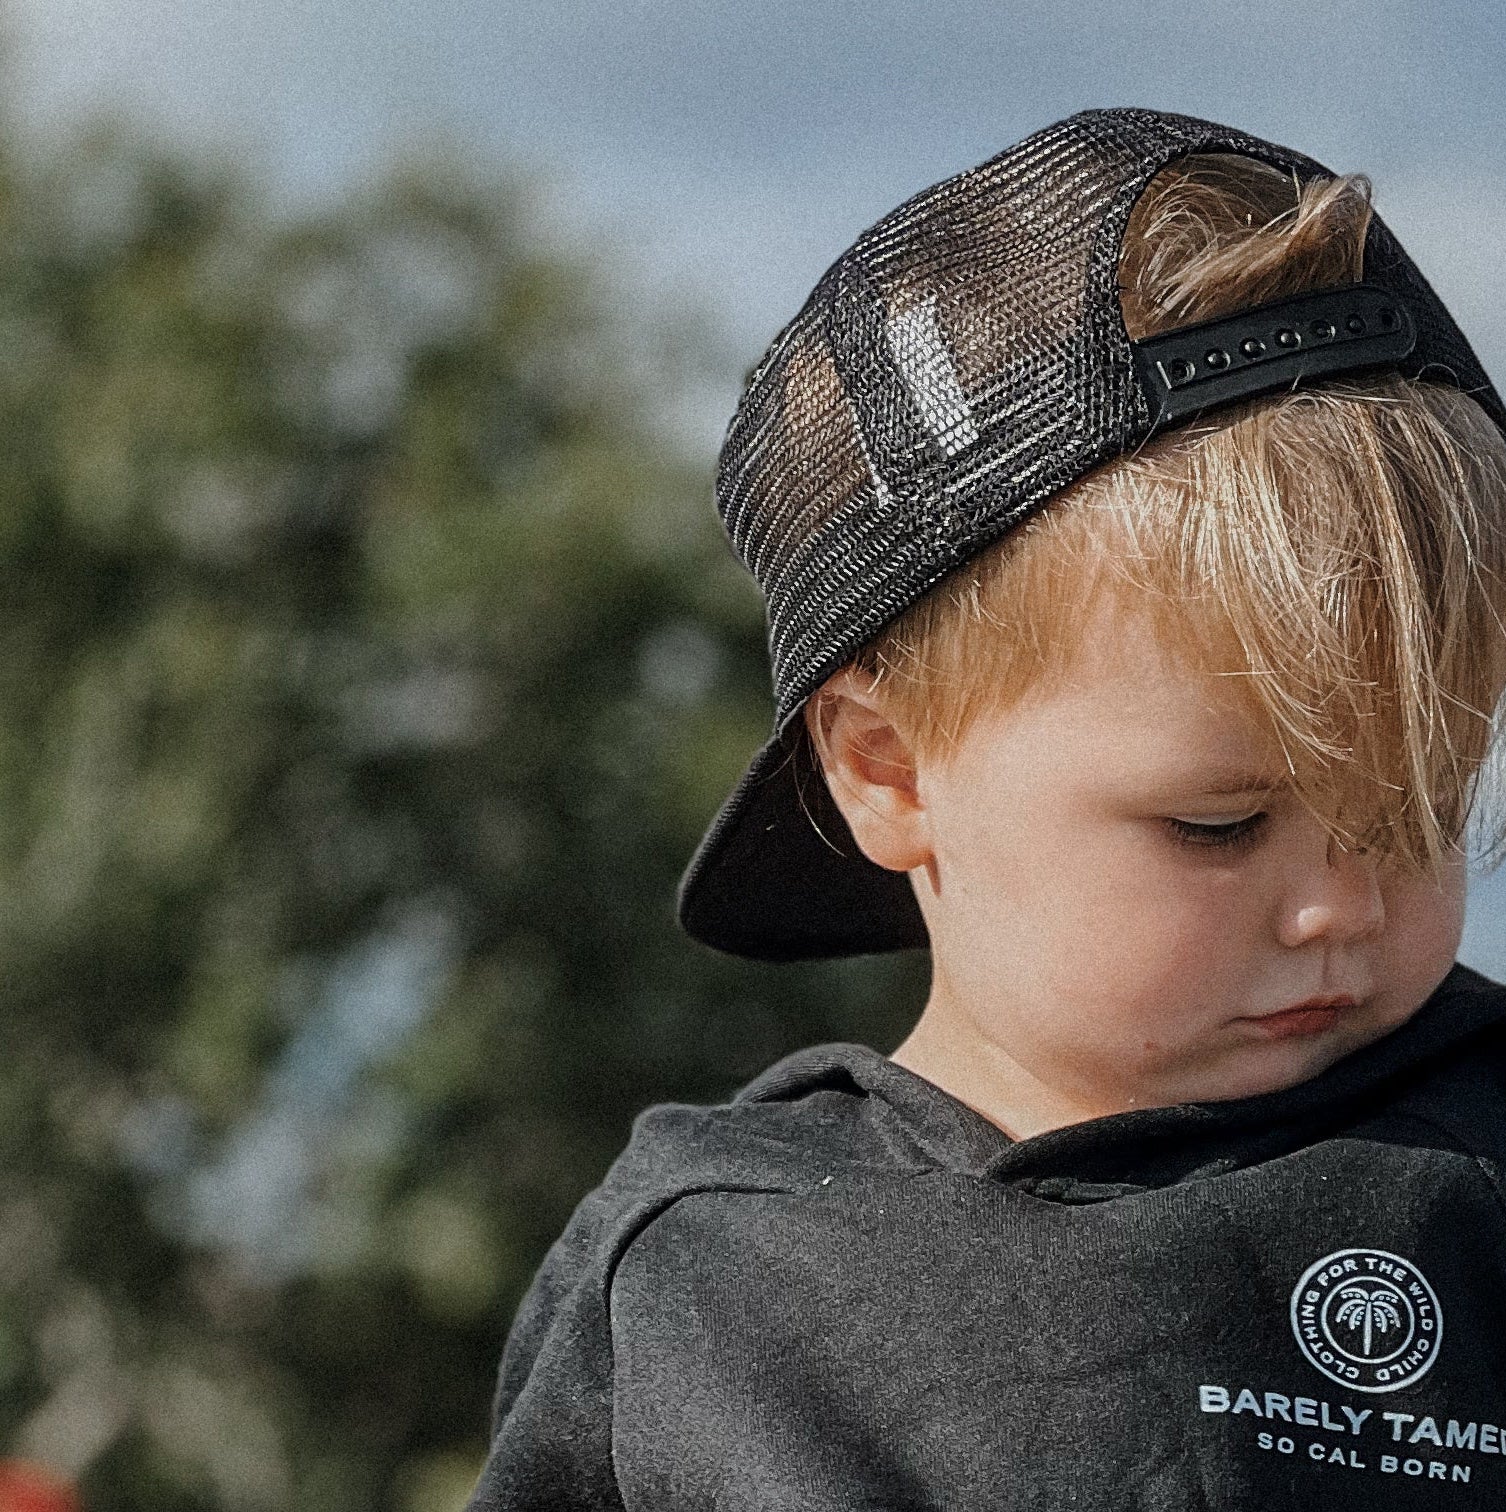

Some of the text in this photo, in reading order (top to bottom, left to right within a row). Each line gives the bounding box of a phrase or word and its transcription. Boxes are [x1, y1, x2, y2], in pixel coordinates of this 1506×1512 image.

[1302, 1290, 1360, 1379] CLOTHING
[1317, 1257, 1433, 1381] FOR THE WILD CHILD
[1199, 1385, 1373, 1435] BARELY
[1257, 1432, 1471, 1483] SO CAL BORN
